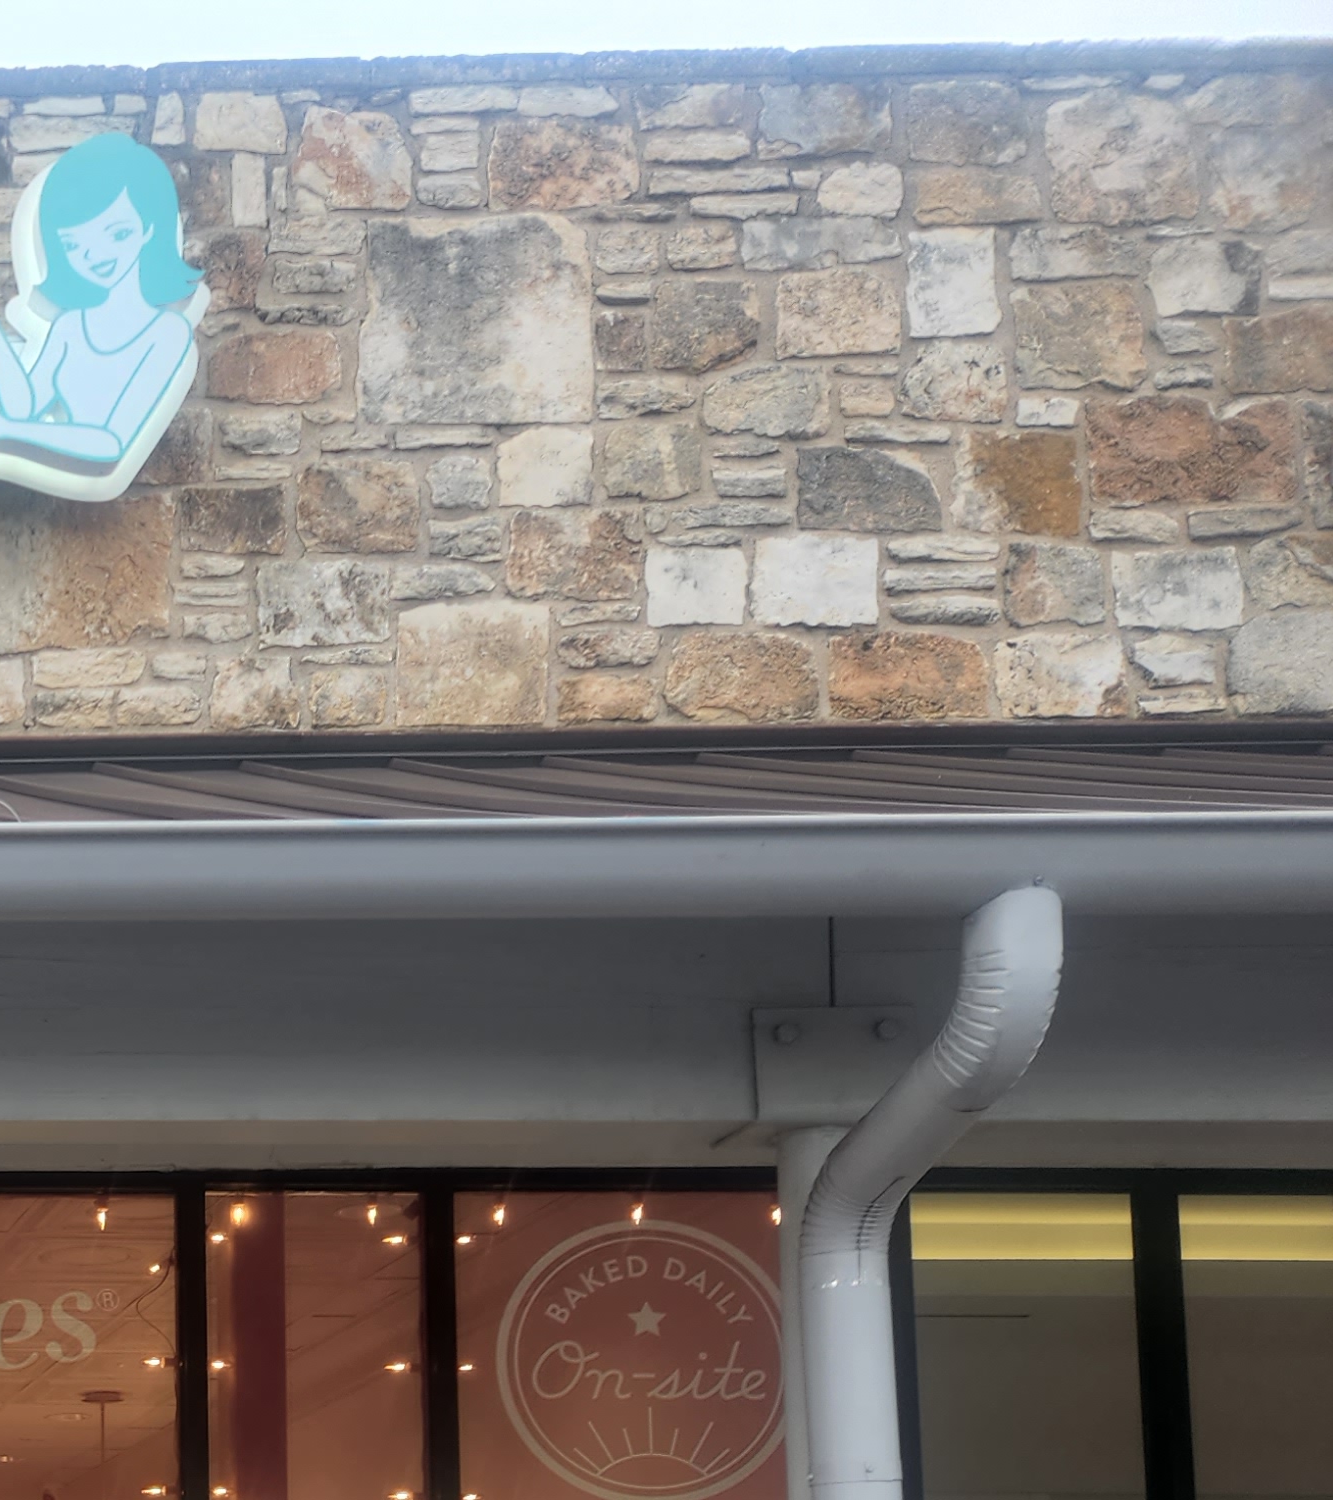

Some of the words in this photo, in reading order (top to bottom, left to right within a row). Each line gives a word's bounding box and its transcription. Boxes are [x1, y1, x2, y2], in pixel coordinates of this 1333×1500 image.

[545, 1255, 650, 1325] BAKED
[662, 1257, 754, 1327] DAILY
[533, 1340, 767, 1400] On-site
